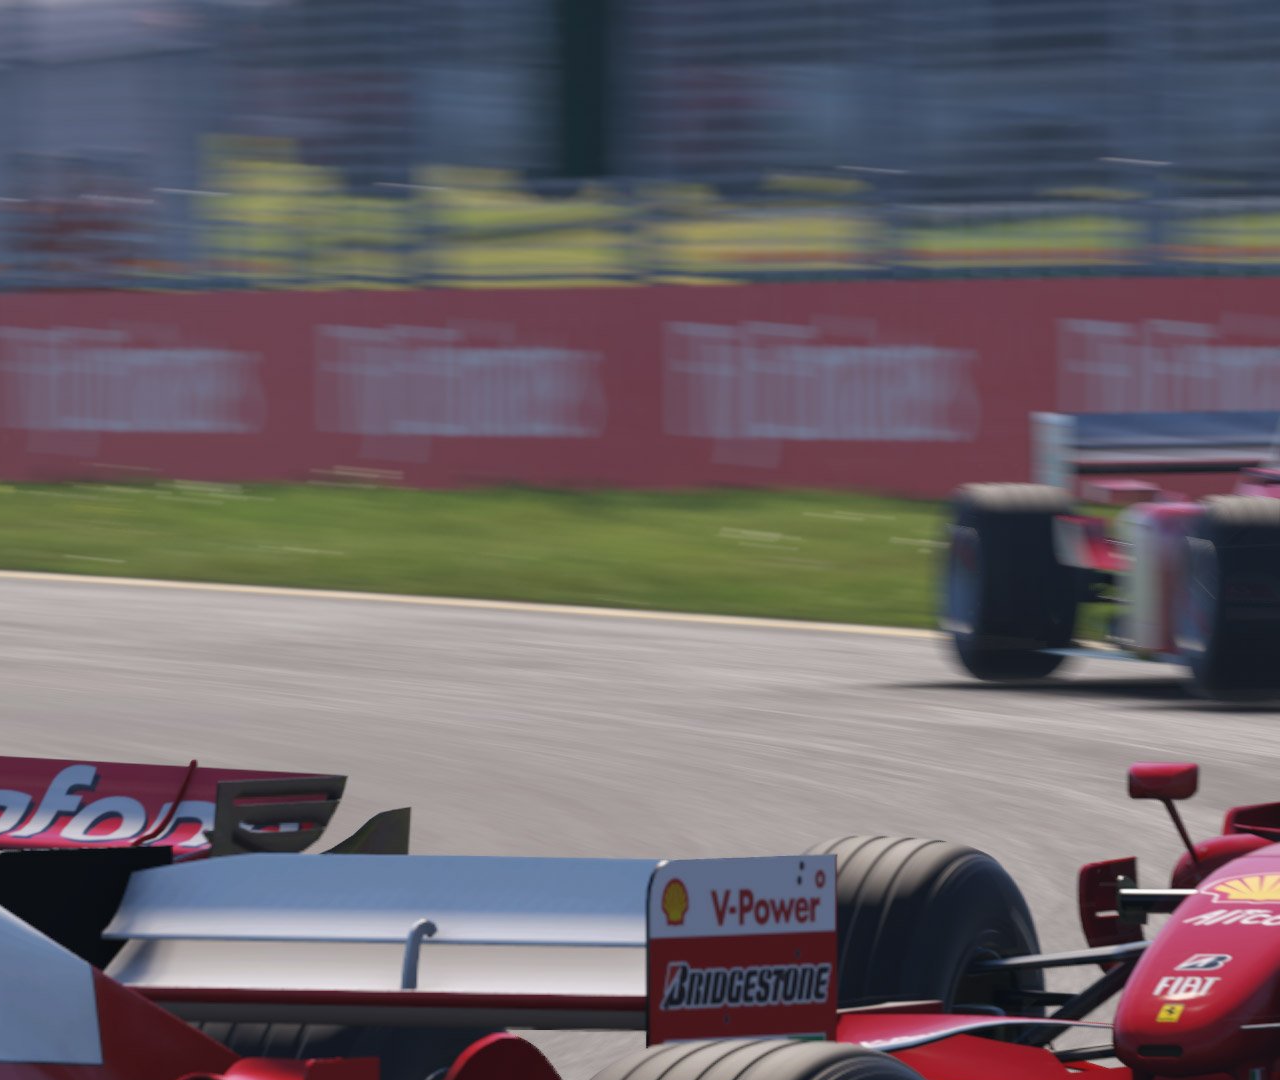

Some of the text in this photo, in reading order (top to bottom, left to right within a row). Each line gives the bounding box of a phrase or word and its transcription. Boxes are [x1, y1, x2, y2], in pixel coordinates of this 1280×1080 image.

[710, 888, 822, 927] V-Power
[659, 960, 833, 1011] BRIDGESTONE
[1151, 975, 1223, 999] FIAT
